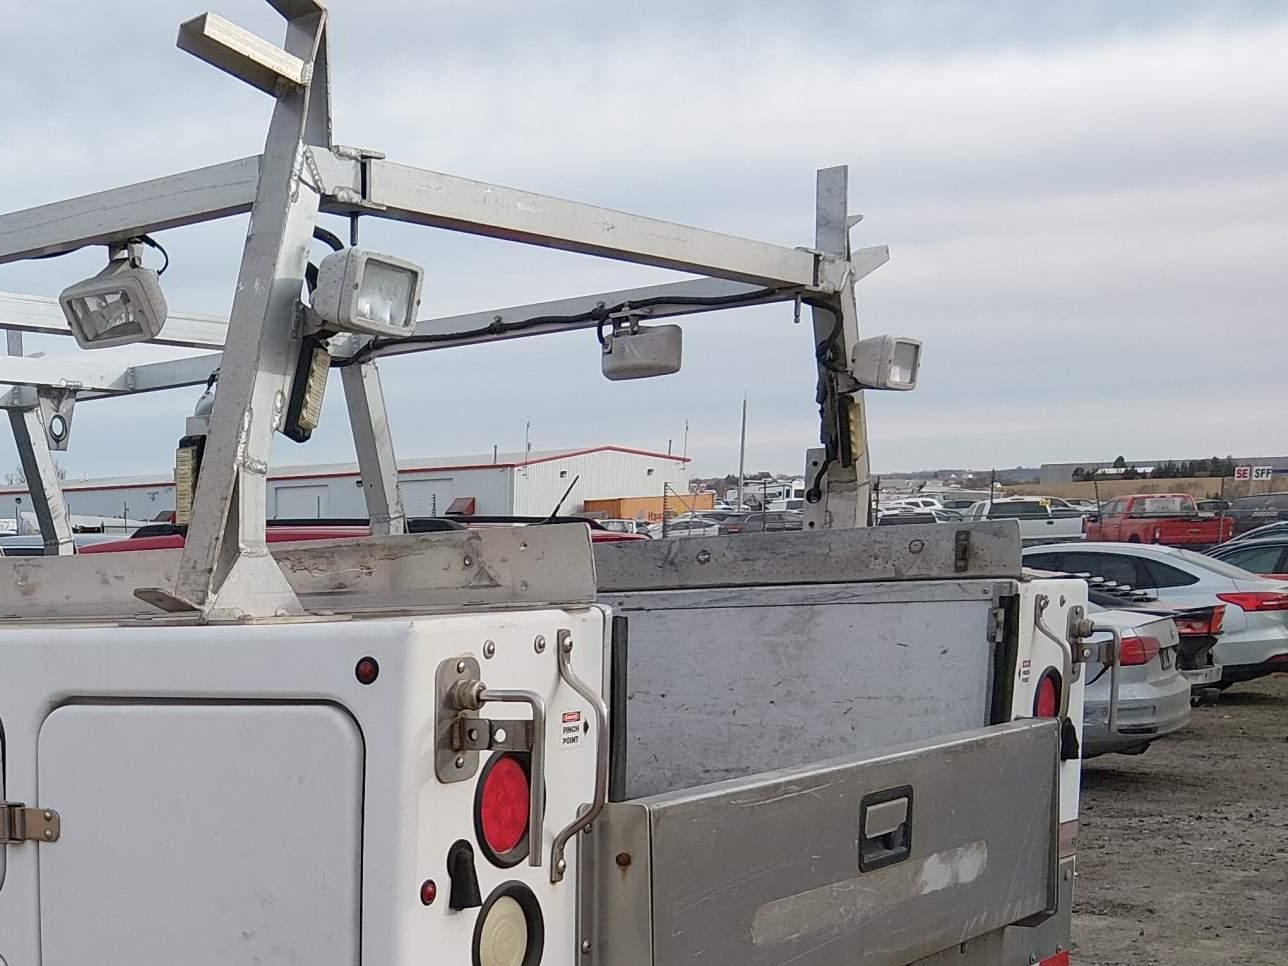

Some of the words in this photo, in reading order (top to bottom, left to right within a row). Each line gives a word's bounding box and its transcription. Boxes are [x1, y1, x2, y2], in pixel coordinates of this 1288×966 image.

[1236, 468, 1249, 479] SE
[1254, 468, 1273, 479] SFF
[562, 725, 580, 735] PINCH
[562, 736, 579, 745] POINT
